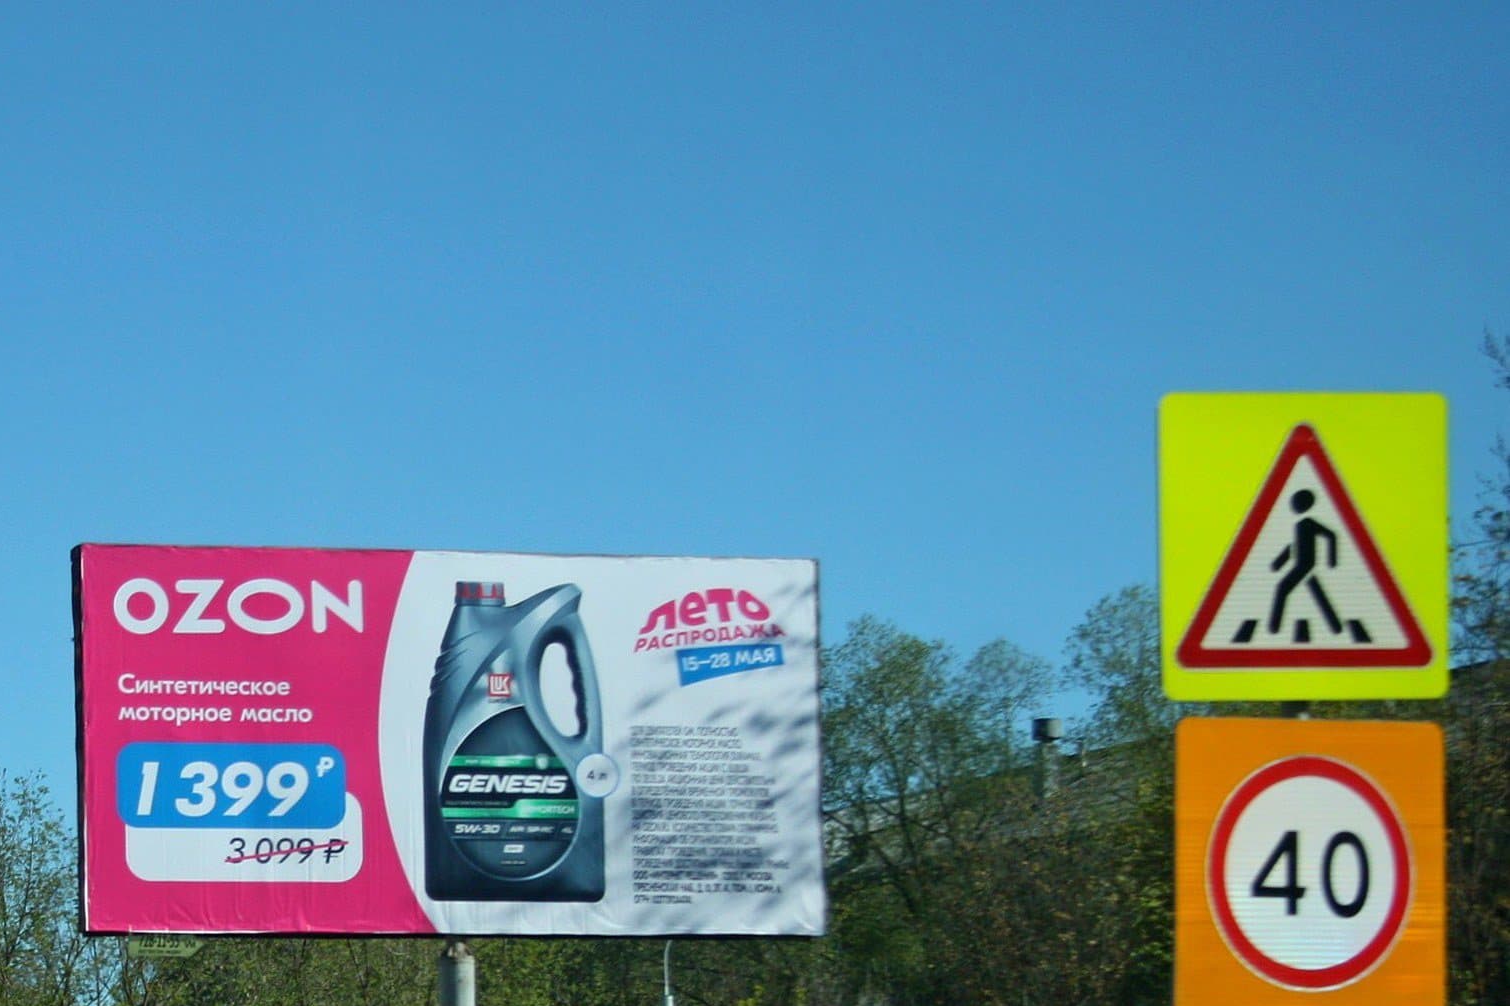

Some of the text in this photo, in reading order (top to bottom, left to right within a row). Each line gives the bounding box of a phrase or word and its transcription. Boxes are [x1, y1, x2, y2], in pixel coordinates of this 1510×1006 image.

[113, 577, 364, 635] OZON
[633, 624, 787, 653] РАСПРОДАЖА
[734, 647, 776, 666] МАЯ
[117, 673, 291, 695] Синтетическое
[118, 705, 313, 726] моторное масло
[448, 773, 568, 795] GENESIS
[454, 823, 501, 834] 5W-30
[1250, 829, 1372, 918] 40
